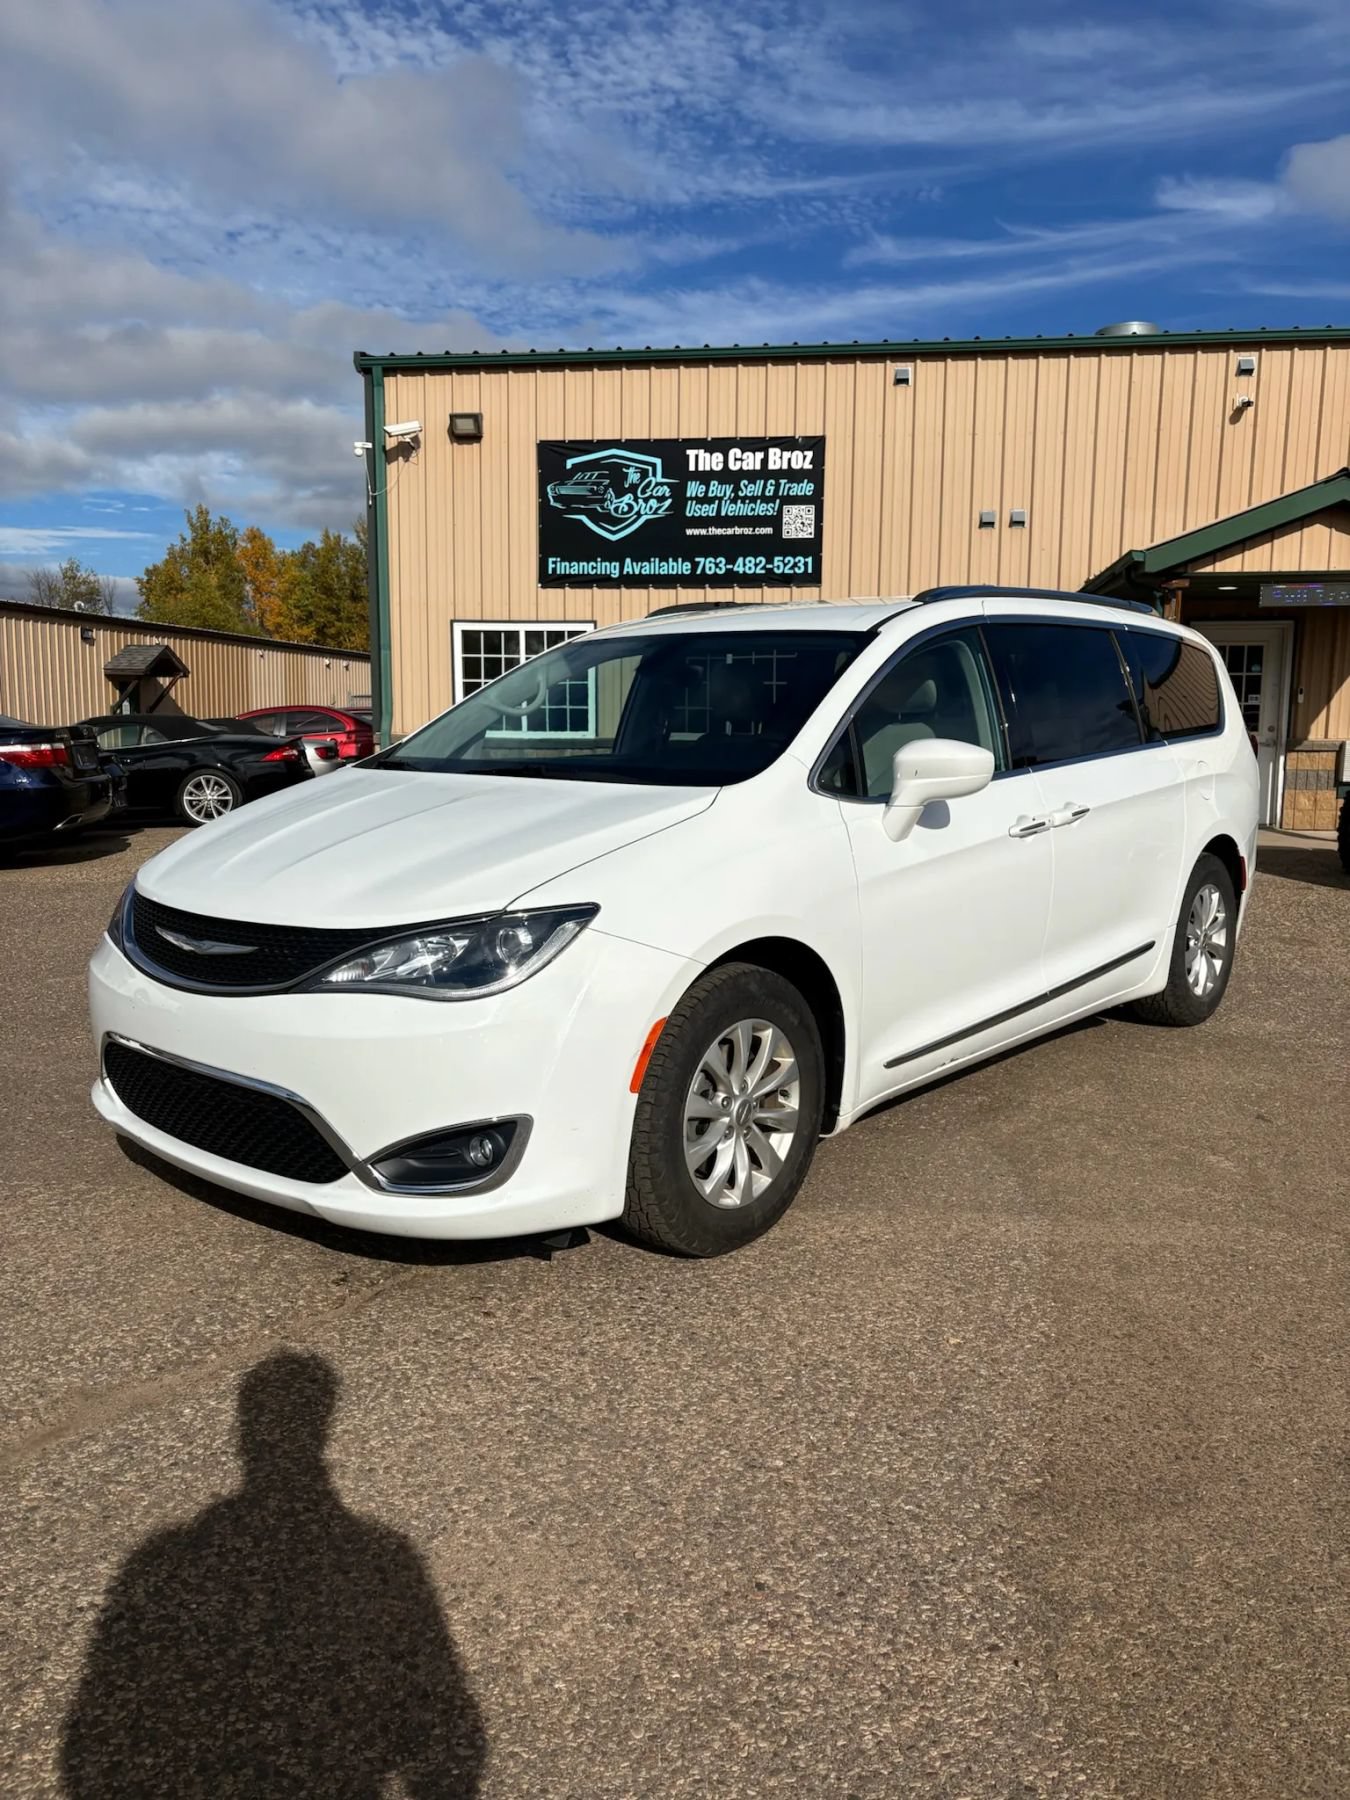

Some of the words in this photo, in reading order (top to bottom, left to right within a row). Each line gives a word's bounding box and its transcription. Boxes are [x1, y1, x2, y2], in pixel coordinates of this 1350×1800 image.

[686, 449, 724, 471] The
[728, 448, 764, 471] Car
[768, 448, 814, 470] Broz
[637, 477, 671, 498] Car
[686, 480, 706, 498] We
[708, 480, 735, 500] Buy,
[738, 479, 764, 497] Sell
[765, 479, 776, 496] &
[778, 479, 815, 496] Trade
[610, 493, 674, 518] Broz
[685, 500, 718, 517] Used
[720, 499, 780, 517] Vehicles!
[685, 526, 774, 536] www.thecarbroz.com
[548, 558, 620, 578] Financing
[623, 557, 691, 576] Available
[695, 556, 814, 575] 763-482-5231
